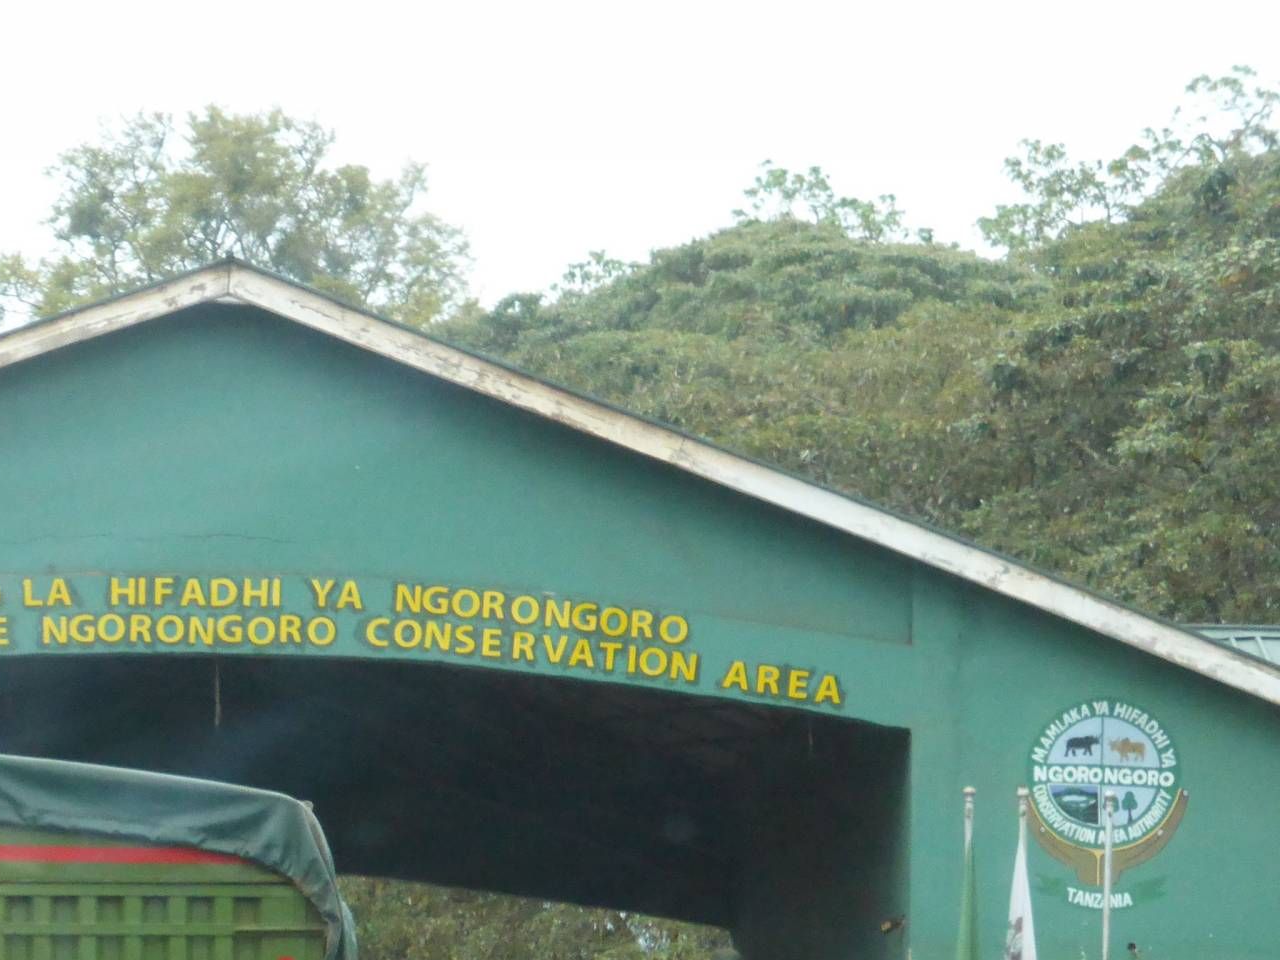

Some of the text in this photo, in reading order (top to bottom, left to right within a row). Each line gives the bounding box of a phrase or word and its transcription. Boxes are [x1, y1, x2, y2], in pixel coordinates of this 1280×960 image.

[22, 578, 73, 609] LA
[109, 575, 282, 610] HIFADHI
[311, 579, 363, 611] YA
[394, 584, 690, 647] NGORONGORO
[42, 613, 337, 648] NGORONGORO
[365, 618, 700, 684] CONSERVATION
[721, 660, 842, 706] AREA
[1031, 701, 1177, 768] MAMLAKA YA HIFADHI YA
[1033, 765, 1175, 787] NGORONGORO
[1032, 784, 1172, 845] CONSERVATION AEA AUTHORITY
